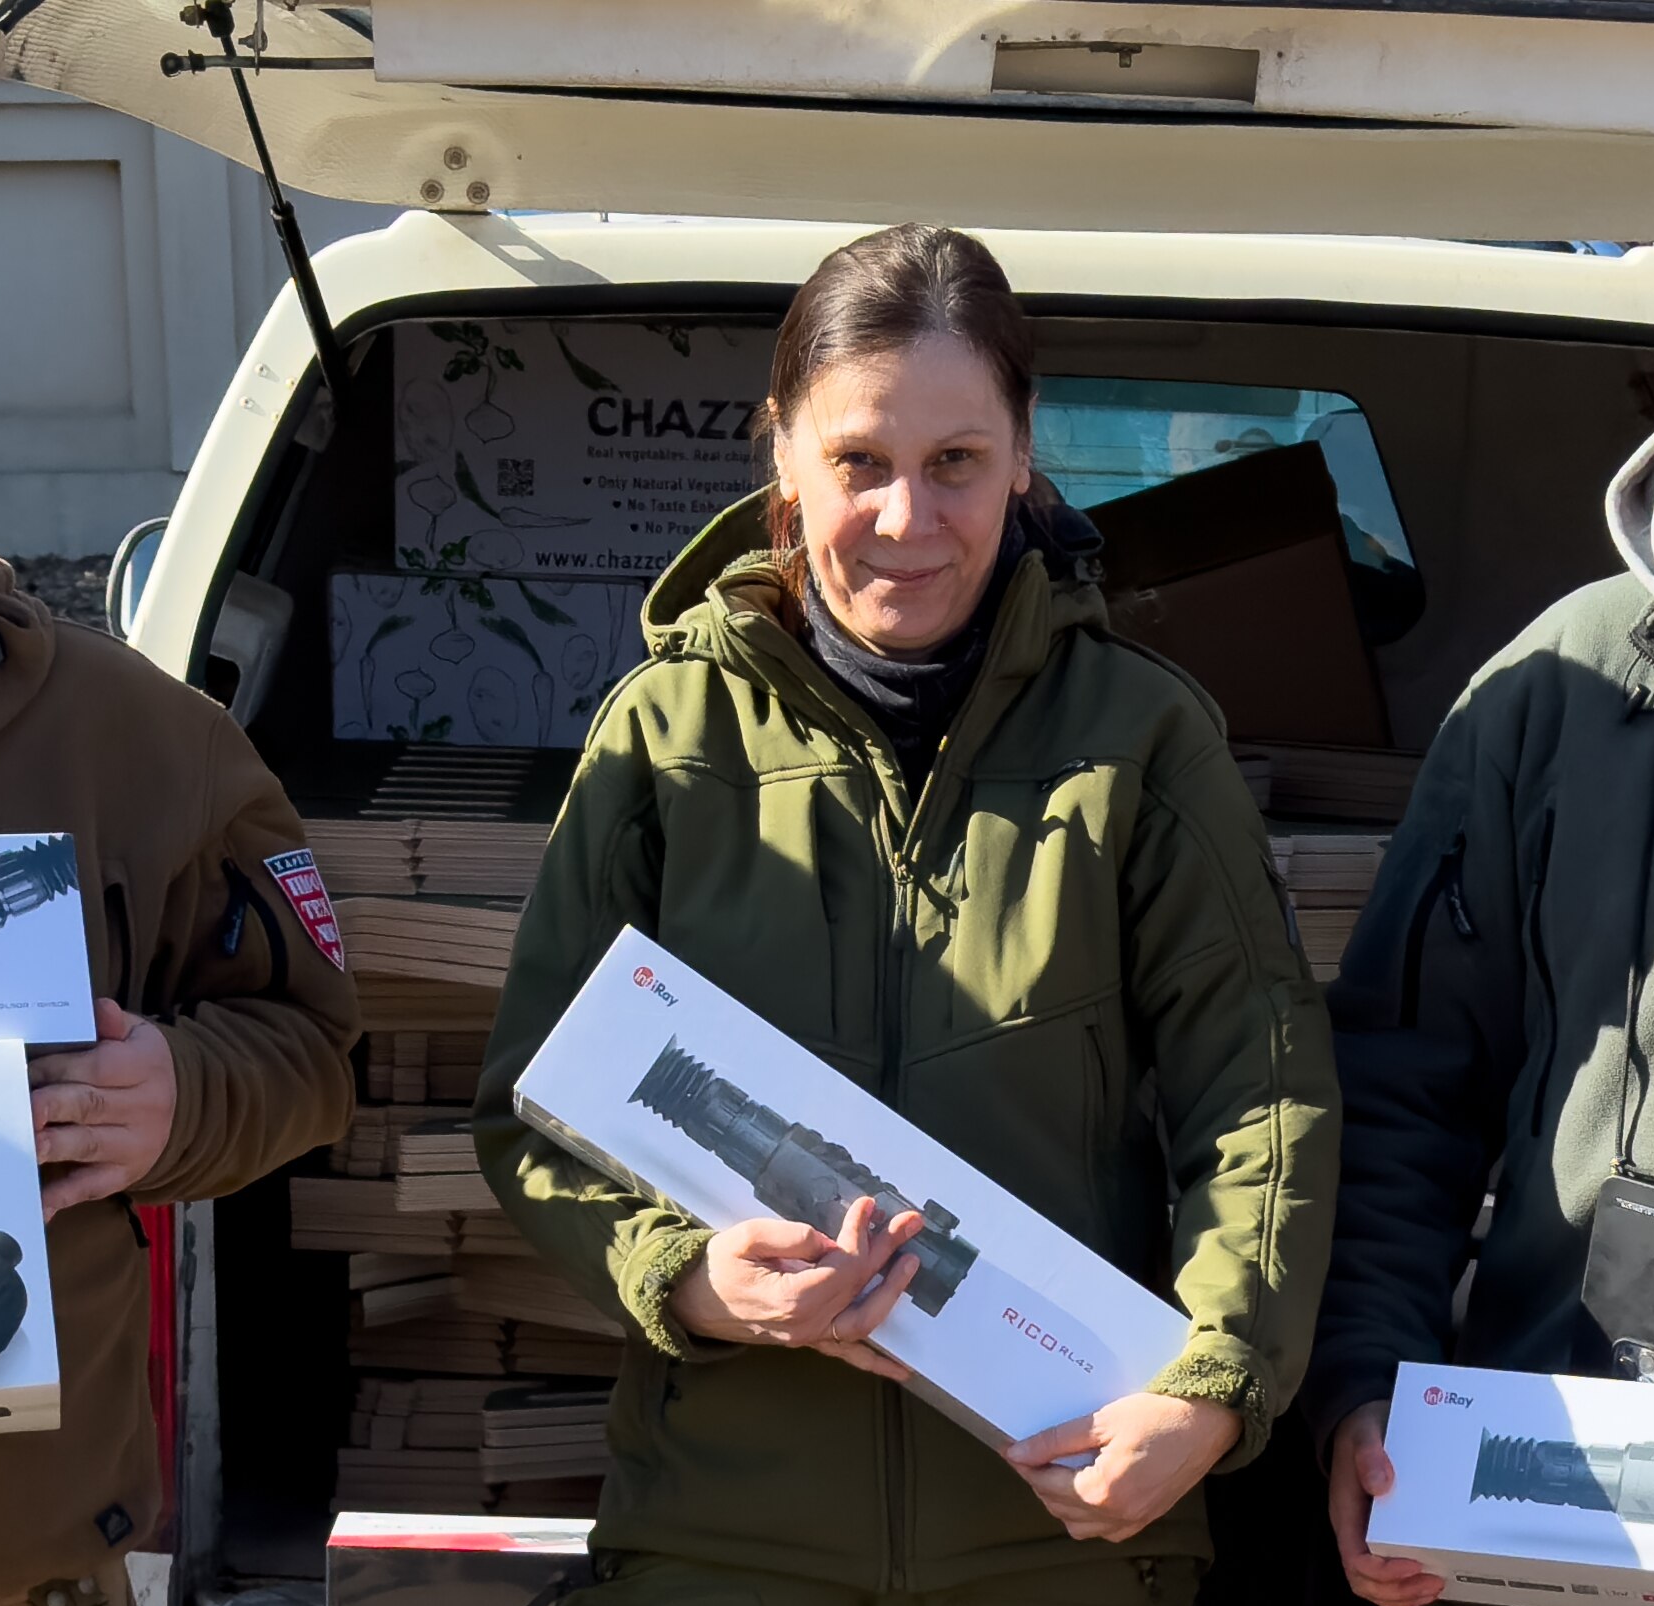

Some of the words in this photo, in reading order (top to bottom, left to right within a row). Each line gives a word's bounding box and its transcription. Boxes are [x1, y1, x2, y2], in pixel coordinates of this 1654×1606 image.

[587, 446, 614, 459] Real
[694, 449, 720, 462] Real
[598, 475, 628, 492] Only
[633, 477, 683, 490] Natural
[628, 499, 646, 512] No
[651, 499, 686, 513] Taste
[645, 520, 663, 534] No
[1002, 1307, 1058, 1352] RICO
[1058, 1345, 1094, 1373] RL42
